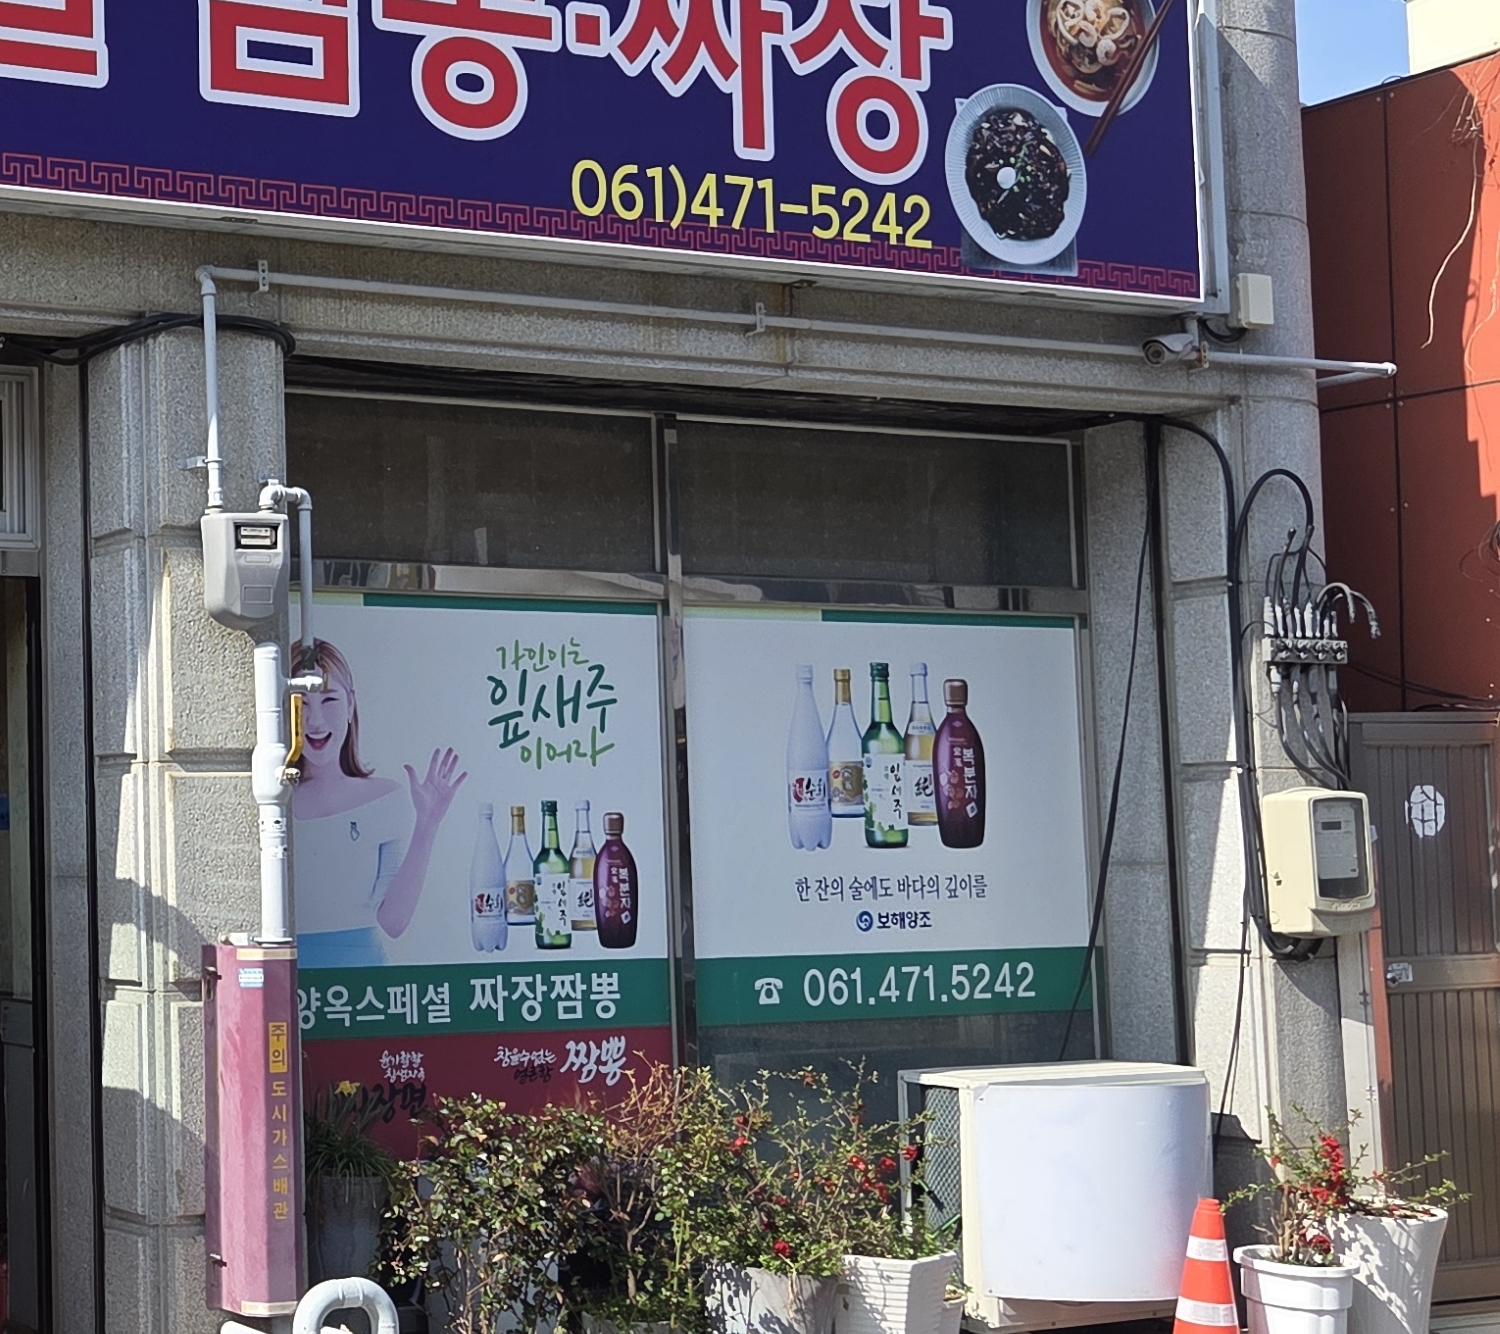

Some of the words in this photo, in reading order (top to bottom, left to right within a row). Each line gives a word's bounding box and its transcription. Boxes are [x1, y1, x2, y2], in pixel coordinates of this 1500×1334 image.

[570, 158, 934, 250] 061)471-5242
[486, 664, 617, 749] 잎새주
[795, 876, 811, 902] 한
[815, 876, 844, 902] 잔의
[848, 875, 893, 901] 술에도
[897, 874, 940, 901] 바다의
[944, 873, 988, 899] 깊이를
[877, 911, 932, 929] 보해양조
[469, 972, 620, 1021] 짜장짬뽕
[803, 961, 1036, 1006] 061.471.5242
[271, 1024, 286, 1067] 주의
[560, 1035, 627, 1086] 짬뽕
[271, 1081, 288, 1220] 도시가스배관
